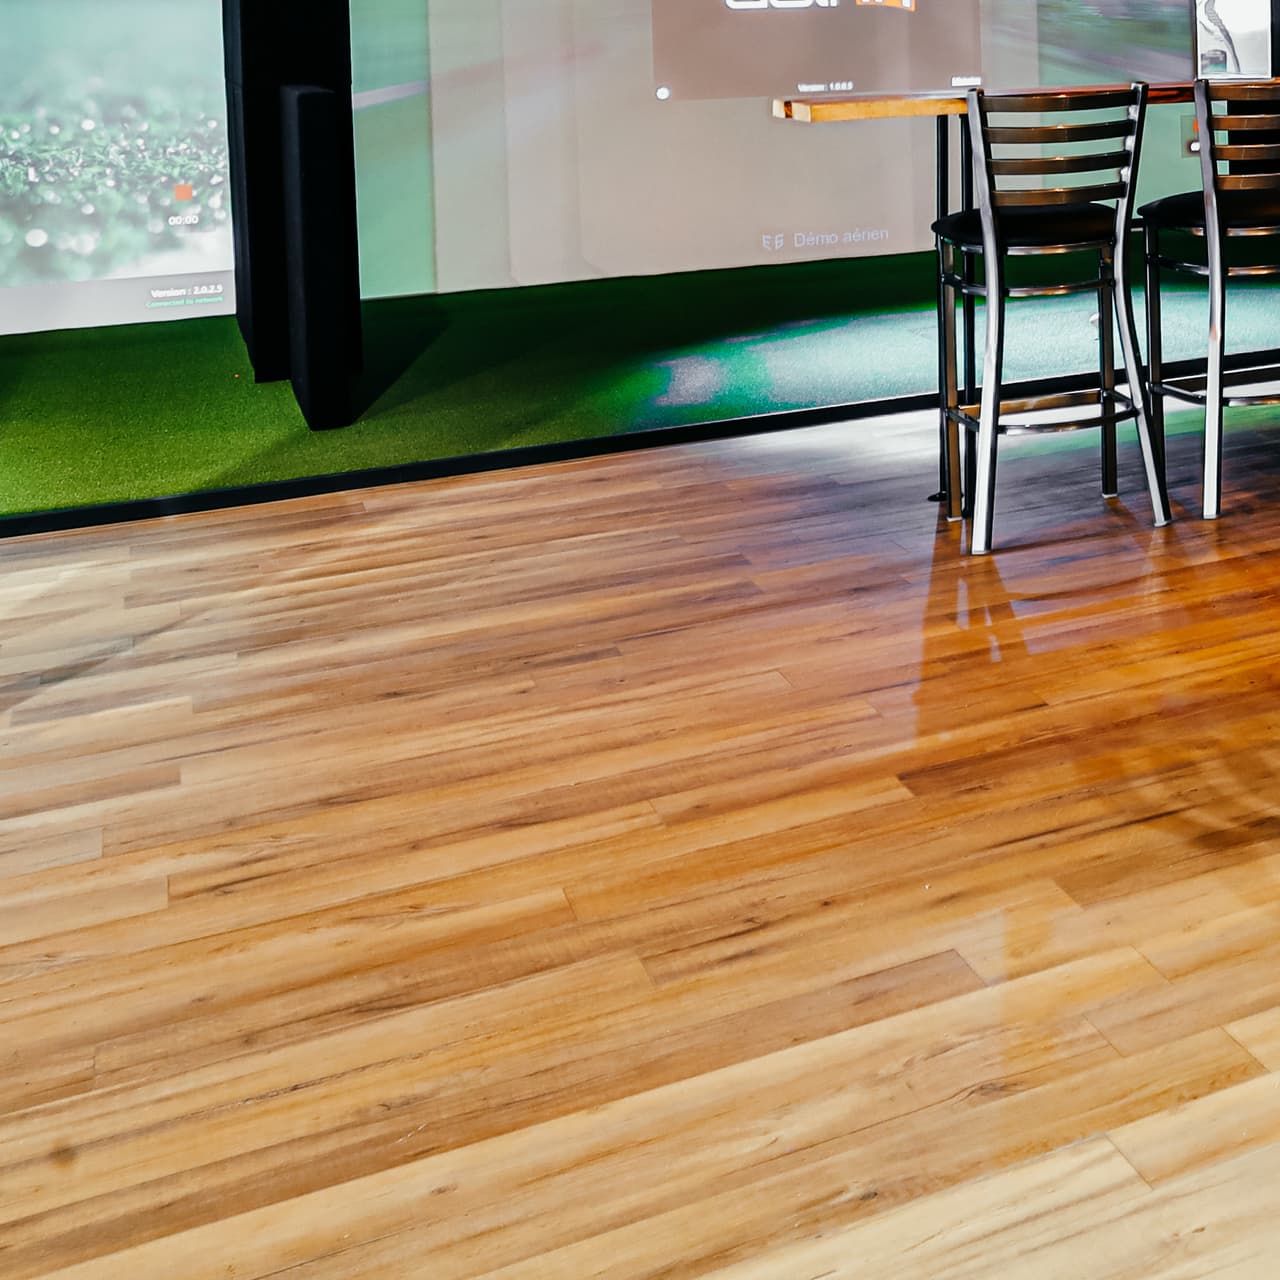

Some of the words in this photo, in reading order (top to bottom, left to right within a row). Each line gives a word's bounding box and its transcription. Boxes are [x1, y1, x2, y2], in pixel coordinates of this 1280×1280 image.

[168, 215, 199, 225] 00:00
[794, 231, 839, 247] Démo
[842, 227, 889, 241] aérien
[151, 288, 186, 298] Version
